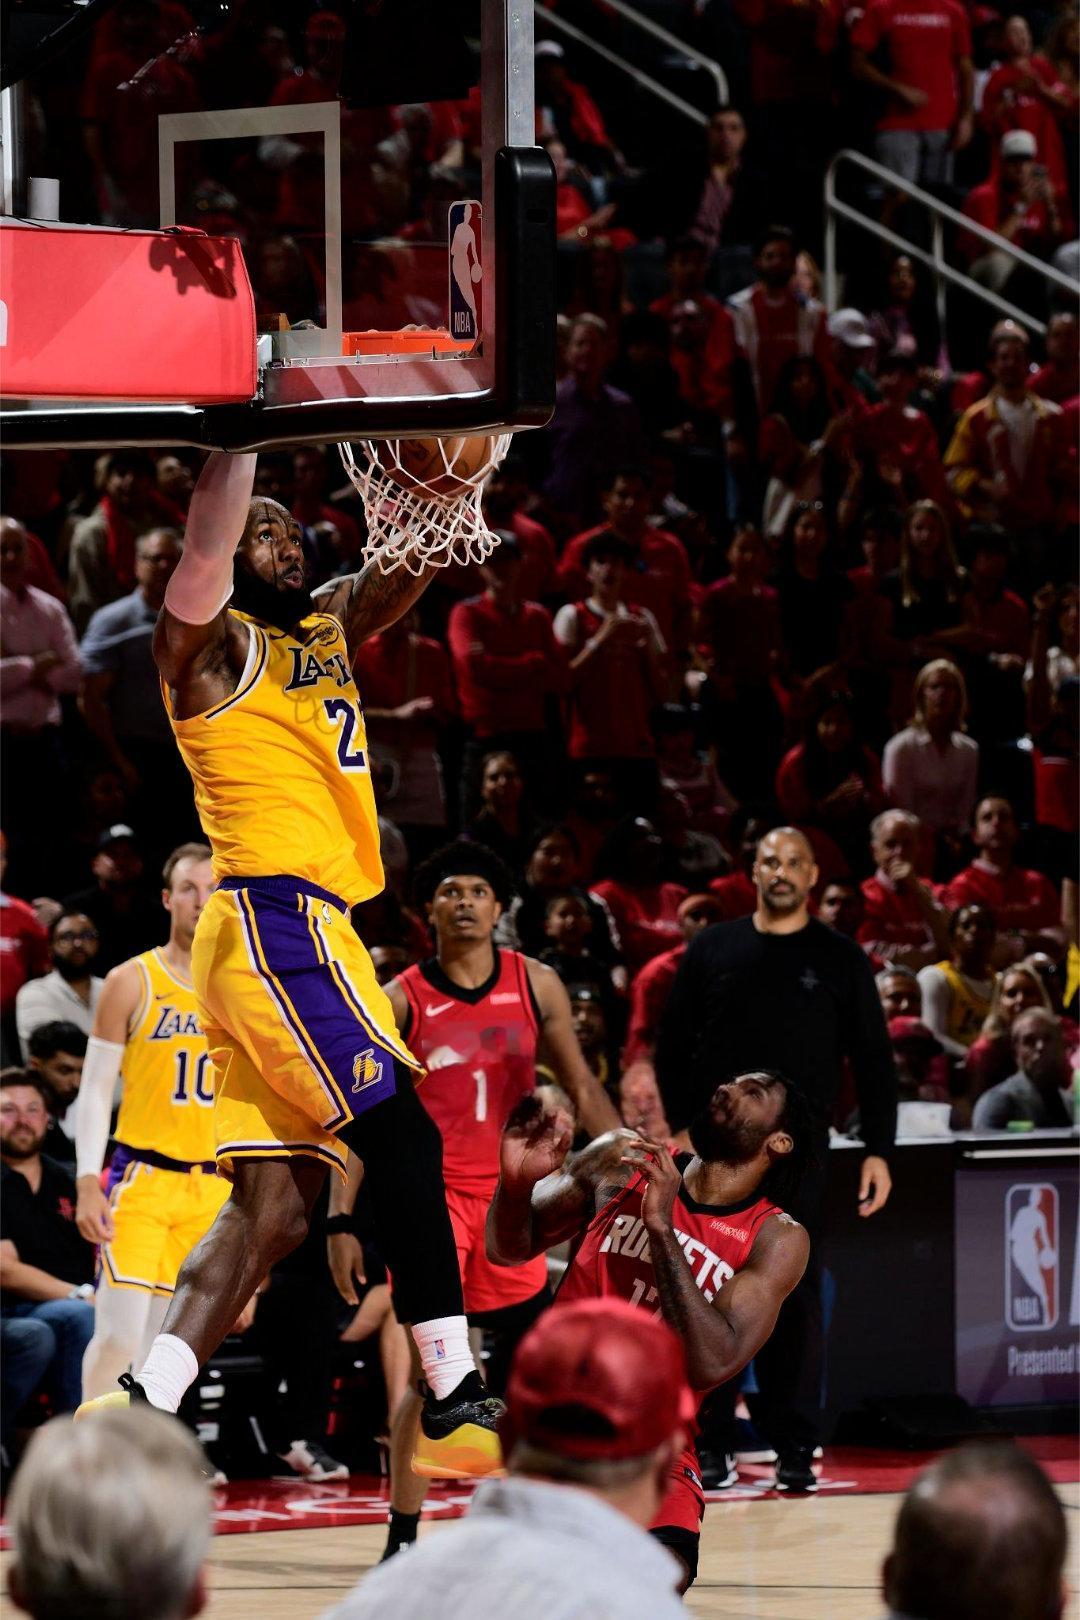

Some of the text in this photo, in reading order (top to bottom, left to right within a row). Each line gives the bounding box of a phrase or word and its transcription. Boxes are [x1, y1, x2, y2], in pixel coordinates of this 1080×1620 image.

[454, 311, 471, 333] NBA
[322, 697, 369, 774] 2
[148, 1006, 206, 1041] LAK
[172, 1048, 216, 1107] 10
[472, 1069, 488, 1122] 1
[598, 1214, 735, 1304] ROETS
[1013, 1296, 1040, 1321] NBA
[1007, 1345, 1075, 1376] Presented
